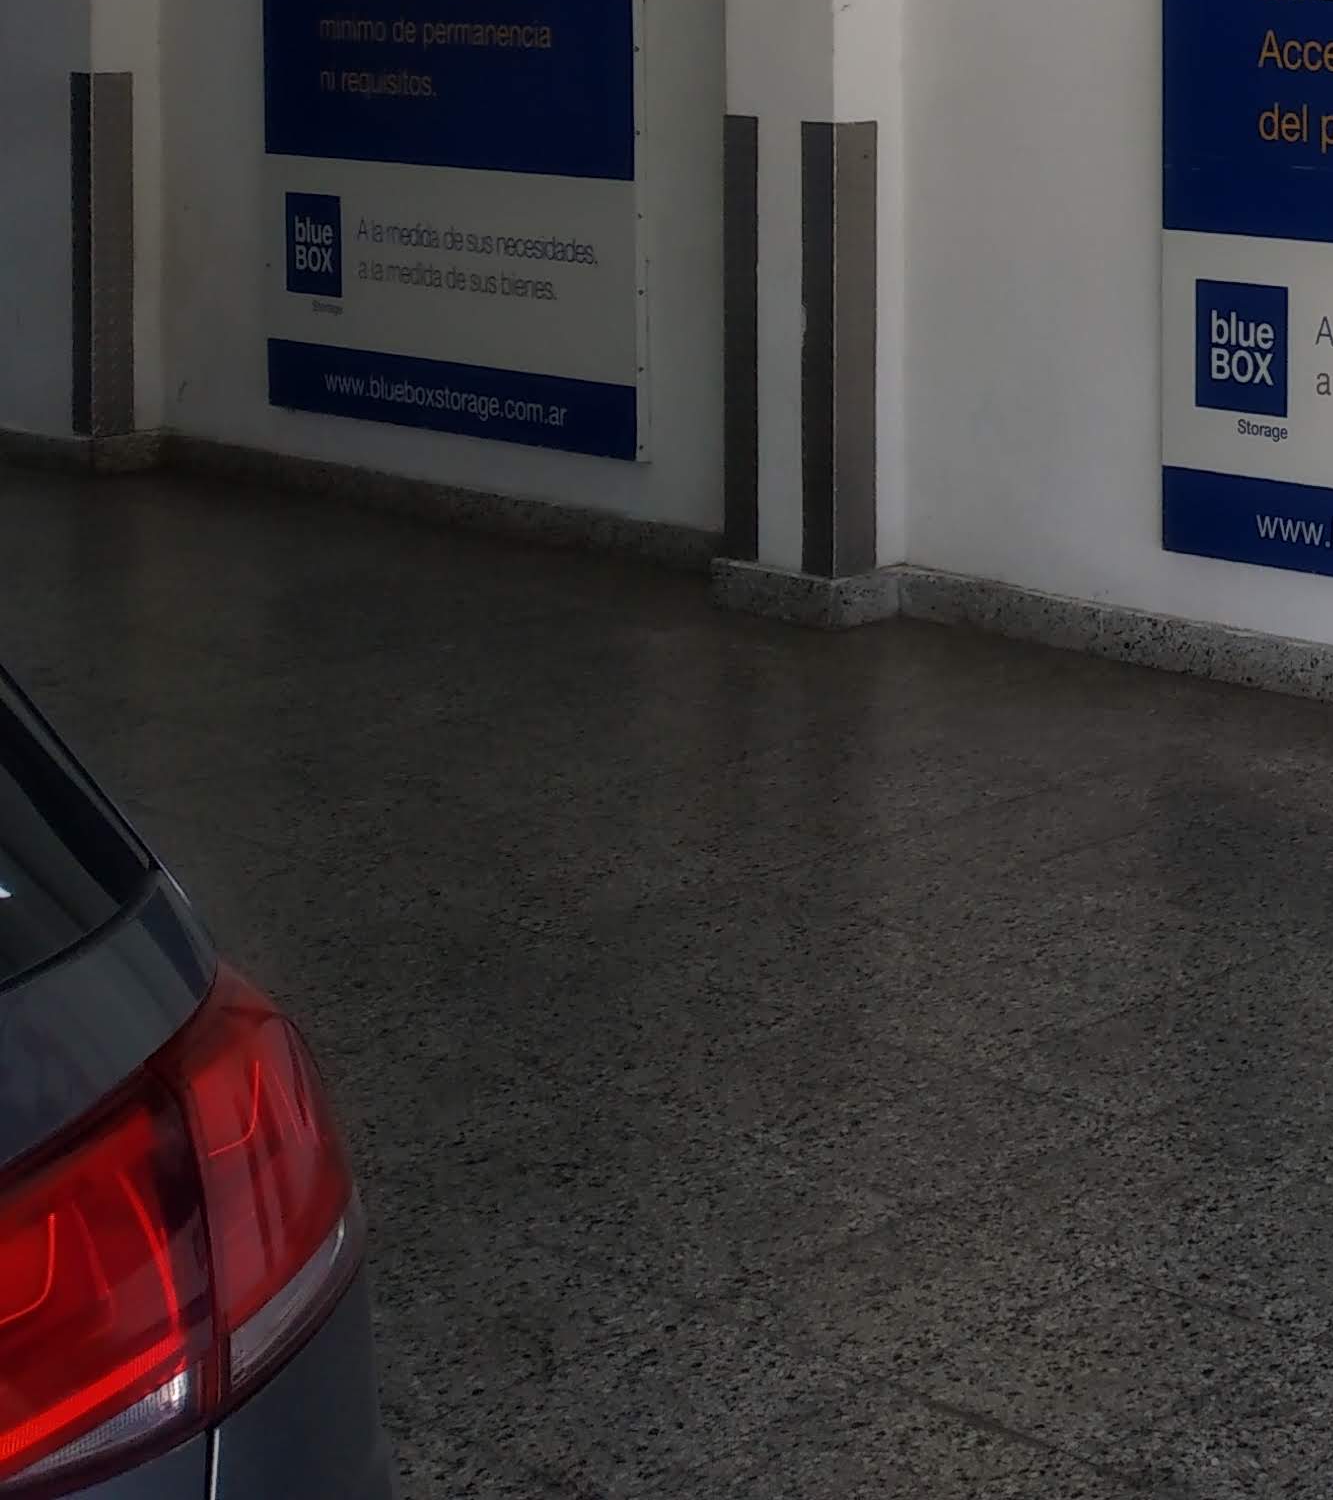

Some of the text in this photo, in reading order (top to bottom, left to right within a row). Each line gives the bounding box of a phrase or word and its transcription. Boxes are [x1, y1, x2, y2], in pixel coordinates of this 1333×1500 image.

[392, 16, 417, 44] de
[422, 20, 552, 52] permanencia
[320, 68, 438, 100] ni requisitos.
[1258, 103, 1308, 142] del
[294, 216, 334, 244] blue
[357, 219, 368, 242] A
[372, 221, 383, 243] la
[386, 222, 439, 247] medida
[446, 226, 464, 251] de
[467, 232, 494, 255] sus
[295, 245, 334, 273] BOX
[358, 260, 557, 301] a la medida de sus bienes.
[1211, 310, 1275, 350] blue
[1211, 351, 1275, 386] BOX
[1316, 373, 1332, 396] a
[322, 370, 568, 427] www.blueboxstorage.com.ar
[1236, 418, 1288, 442] Storage
